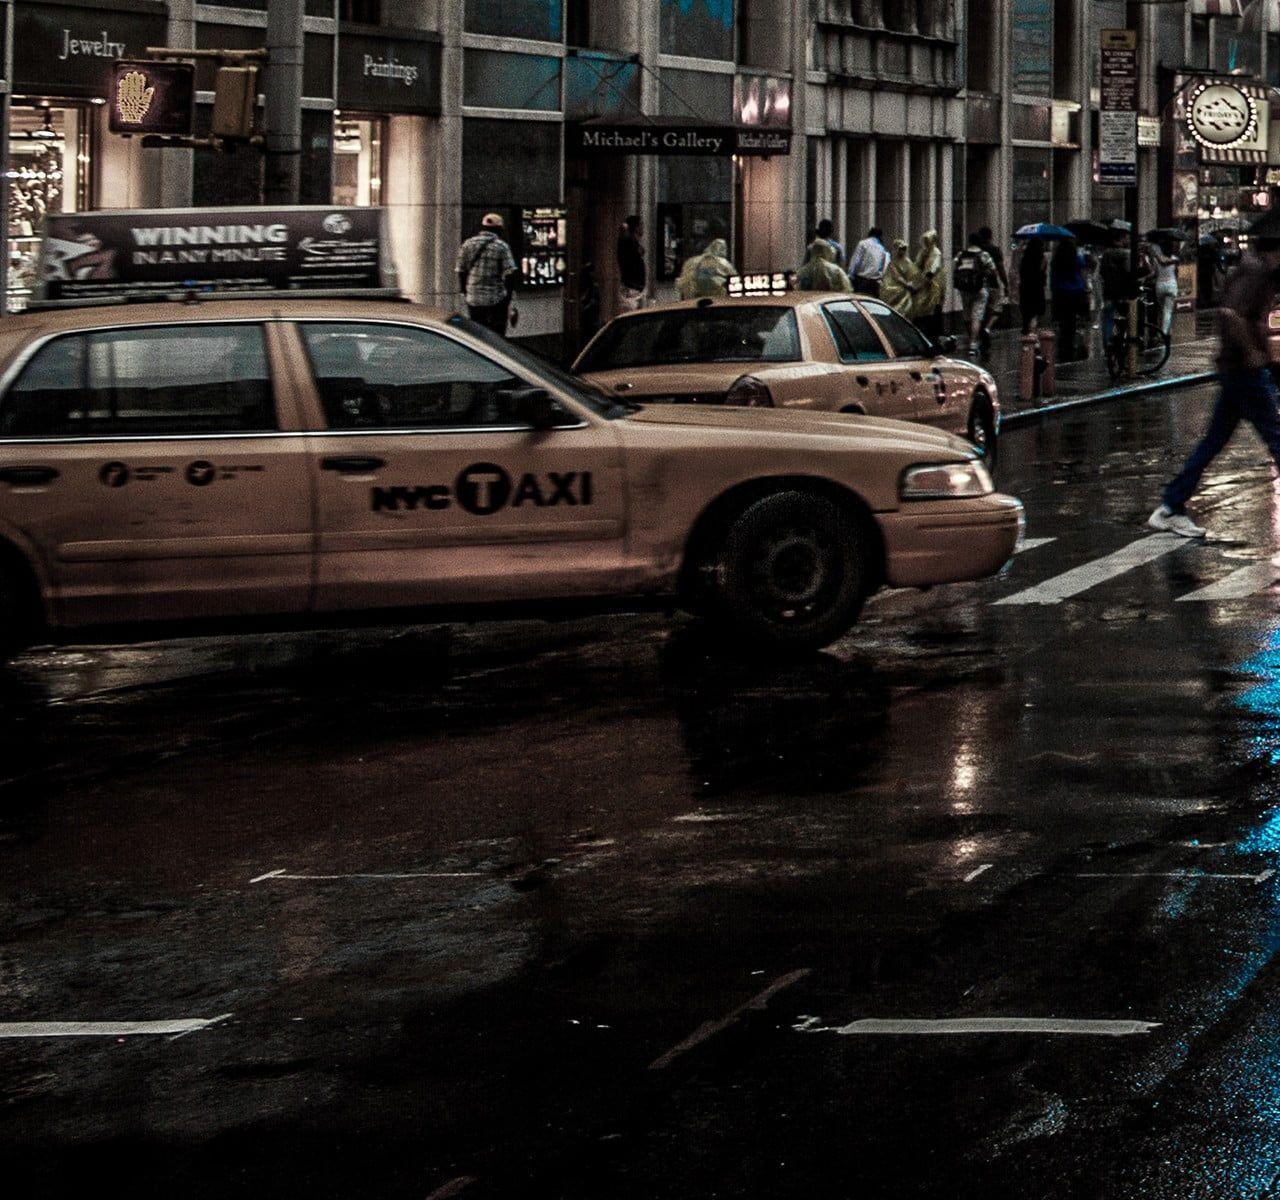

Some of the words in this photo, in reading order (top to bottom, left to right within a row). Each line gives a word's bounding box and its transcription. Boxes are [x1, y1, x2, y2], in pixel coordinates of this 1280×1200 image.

[59, 29, 125, 59] Jewelry
[363, 54, 419, 86] Paintings
[583, 132, 658, 147] Michael's
[663, 132, 722, 152] Gallery
[132, 224, 287, 247] WINNING
[371, 485, 456, 512] NYC
[456, 461, 593, 515] TAXI
